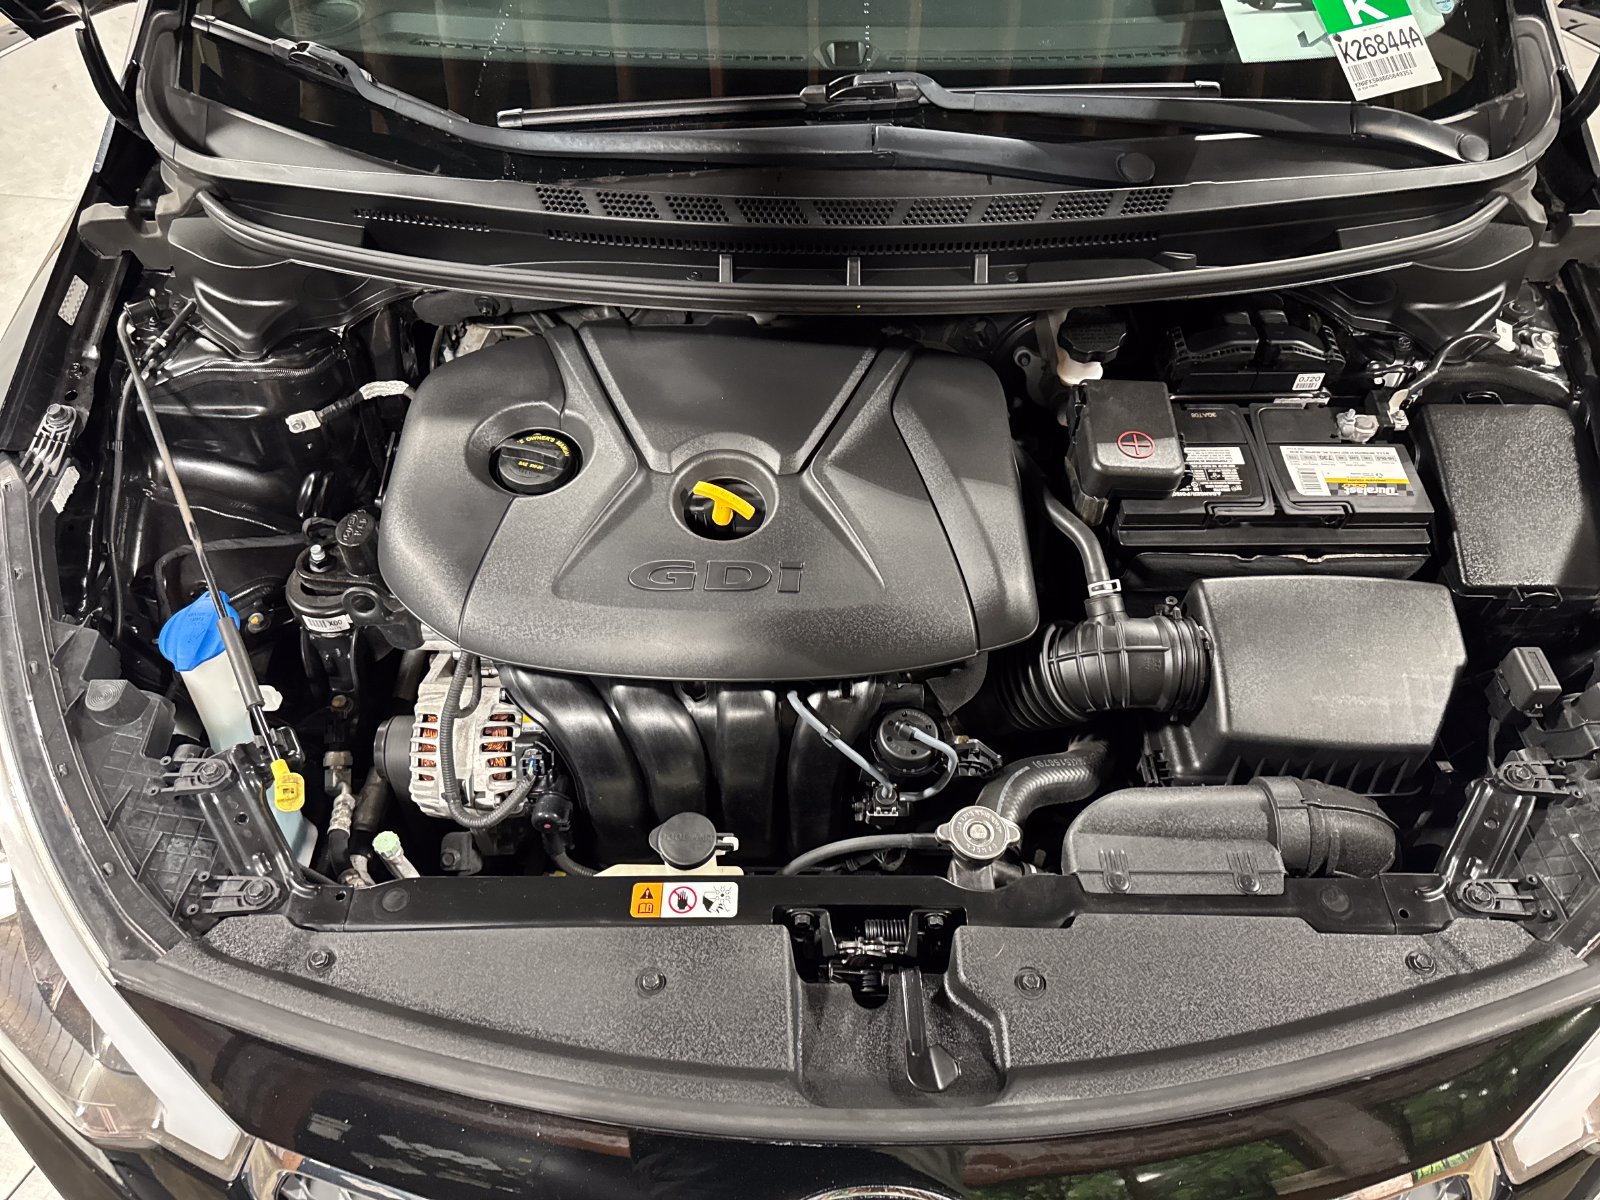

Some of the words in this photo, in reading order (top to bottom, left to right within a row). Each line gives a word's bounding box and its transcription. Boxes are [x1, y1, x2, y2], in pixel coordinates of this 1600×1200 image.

[1337, 26, 1423, 64] K26844A
[525, 435, 556, 443] OWNER'S
[1343, 486, 1400, 496] Duralast
